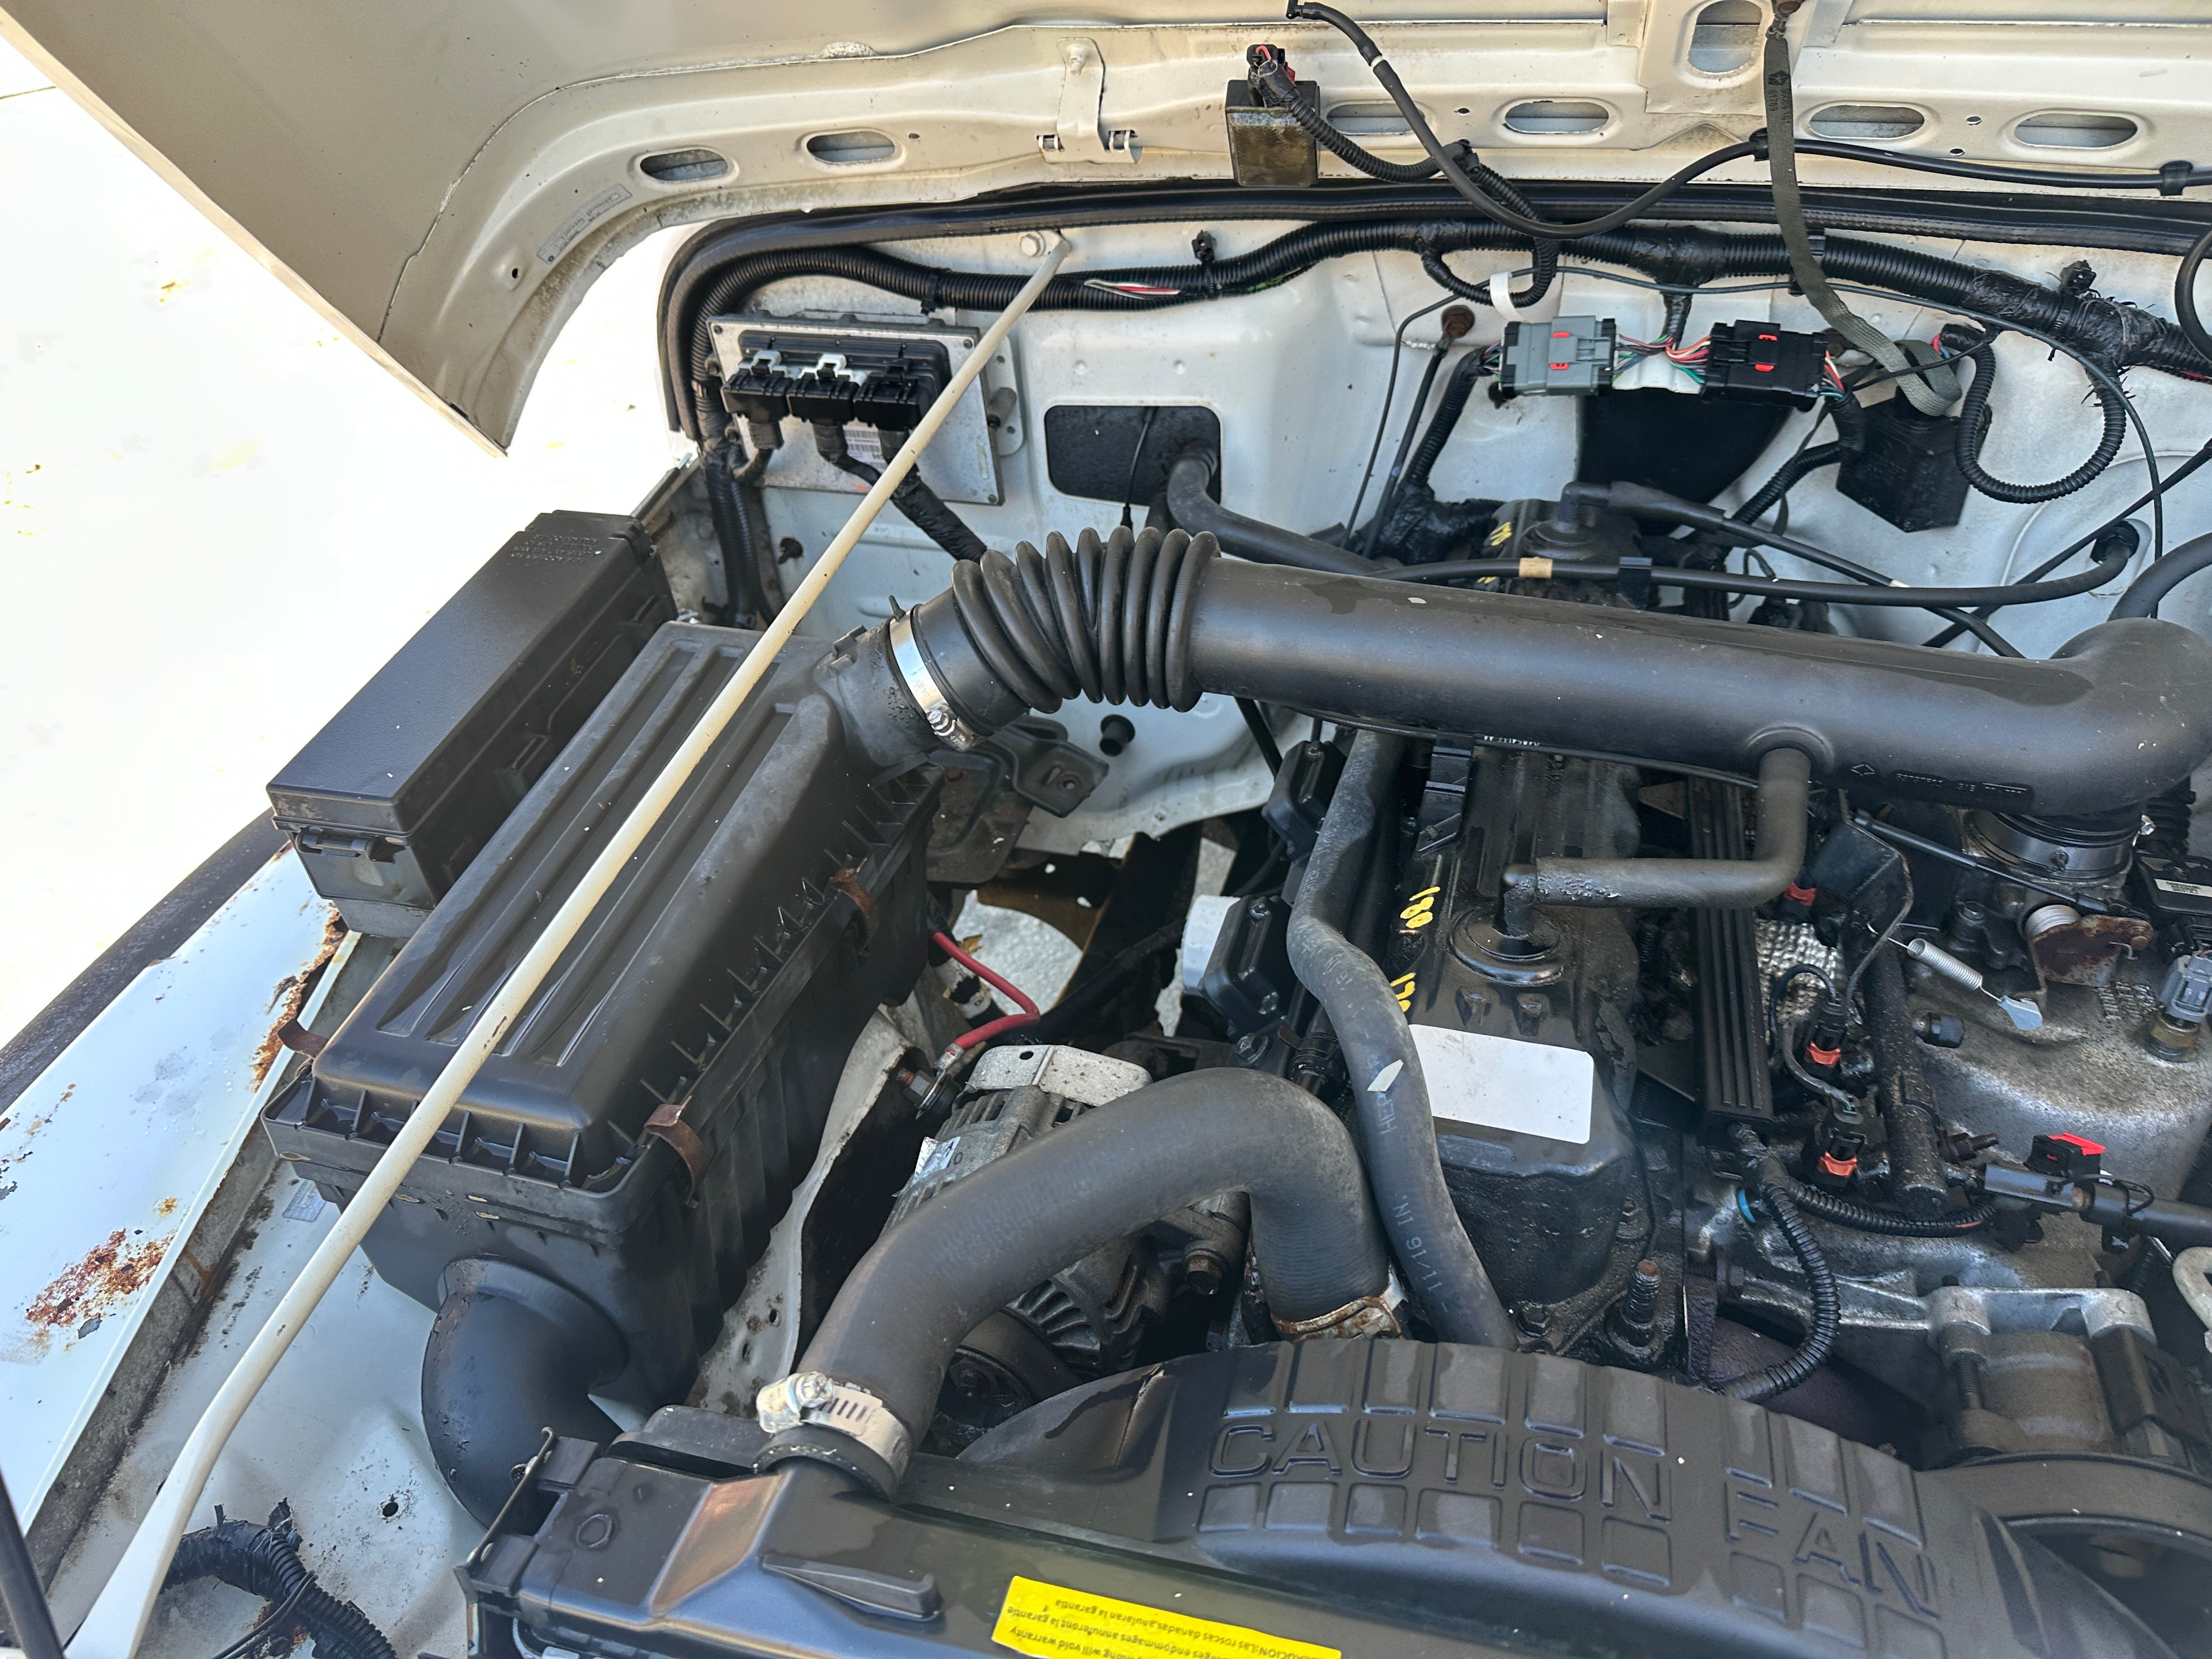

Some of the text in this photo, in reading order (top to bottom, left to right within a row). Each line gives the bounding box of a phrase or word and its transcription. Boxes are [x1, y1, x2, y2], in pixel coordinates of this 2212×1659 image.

[1367, 1054, 1397, 1135] HEAR
[1406, 1236, 1443, 1292] 11/16
[1207, 1423, 1942, 1619] CAUTION FAN
[1007, 1605, 1050, 1623] garantie
[1055, 1599, 1097, 1615] garantia
[1098, 1609, 1108, 1619] la
[1050, 1618, 1059, 1628] la
[1109, 1611, 1154, 1627] anularan
[1009, 1625, 1056, 1645] warranty
[1202, 1632, 1237, 1647] roscas
[1058, 1639, 1081, 1652] void
[1081, 1645, 1101, 1657] will
[1120, 1634, 1191, 1657] endommages
